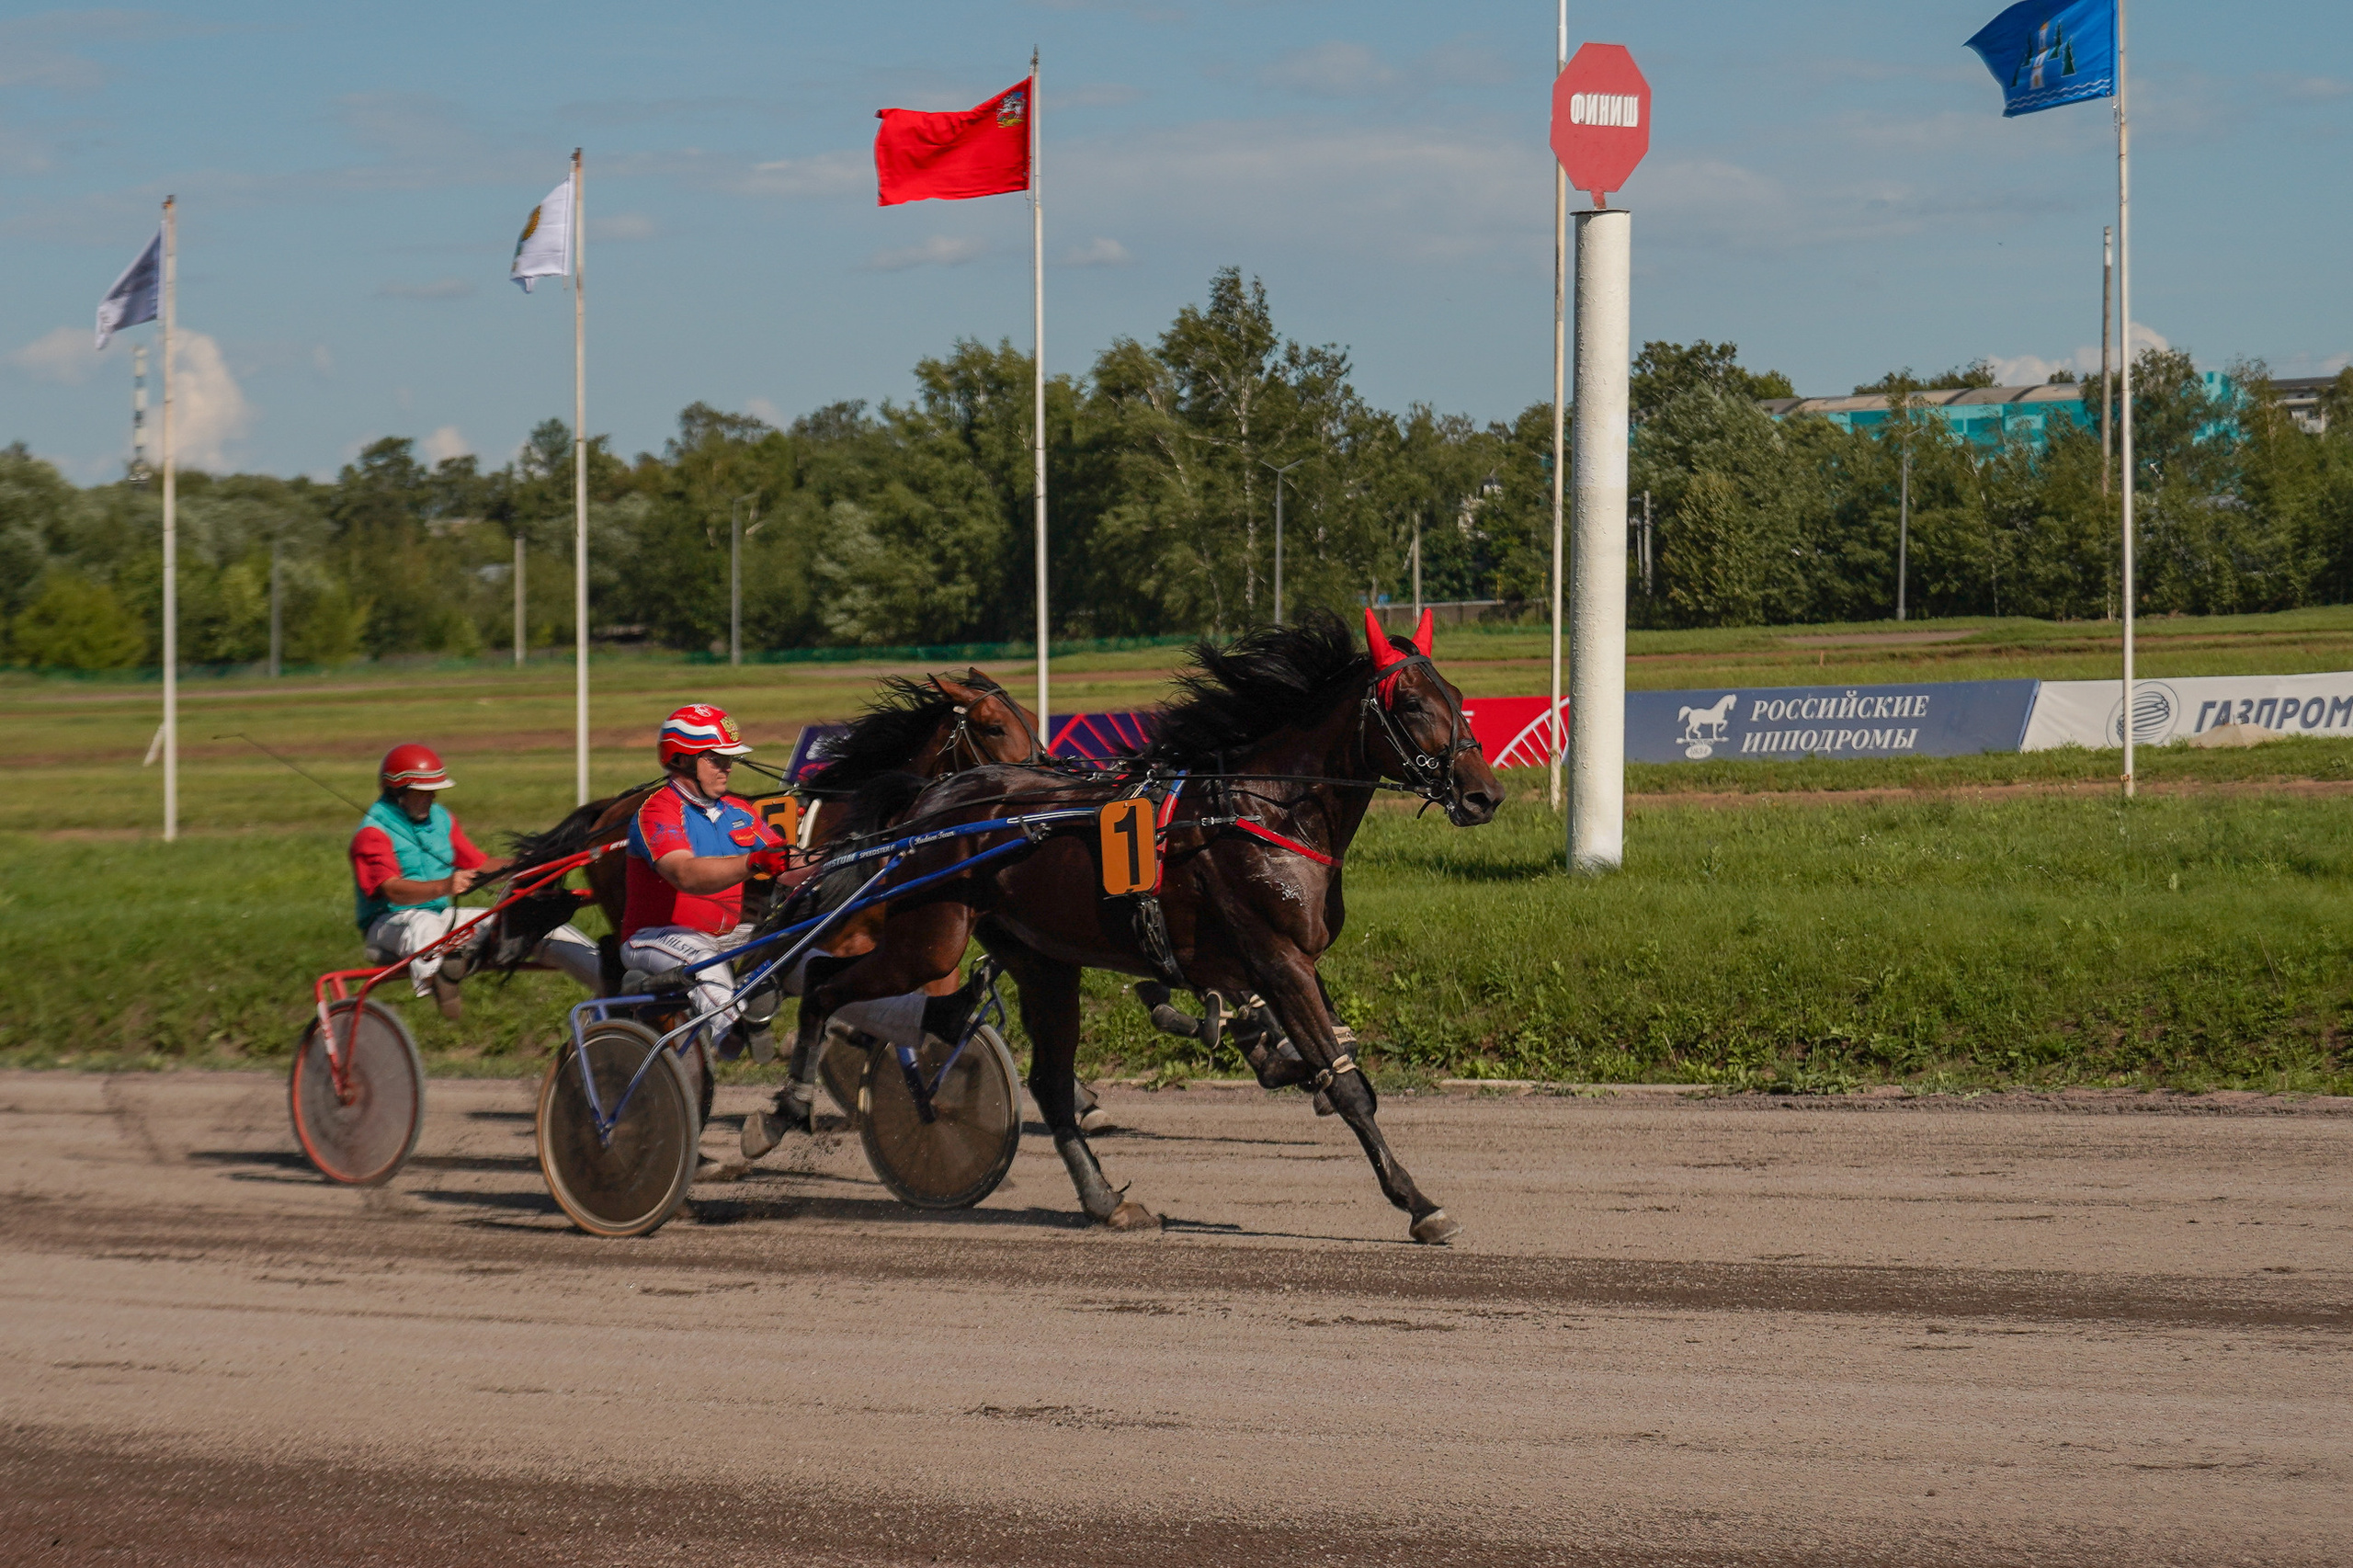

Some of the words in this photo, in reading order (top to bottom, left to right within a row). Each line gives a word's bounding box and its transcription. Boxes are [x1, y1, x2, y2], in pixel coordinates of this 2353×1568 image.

[1570, 93, 1639, 127] ФИНИШ
[1750, 690, 1929, 722] РОССИЙСКИЕ
[2194, 696, 2353, 733] ГАЗПРОМ
[1740, 728, 1918, 754] ИППОДРОМЫ
[1114, 806, 1140, 885] 1
